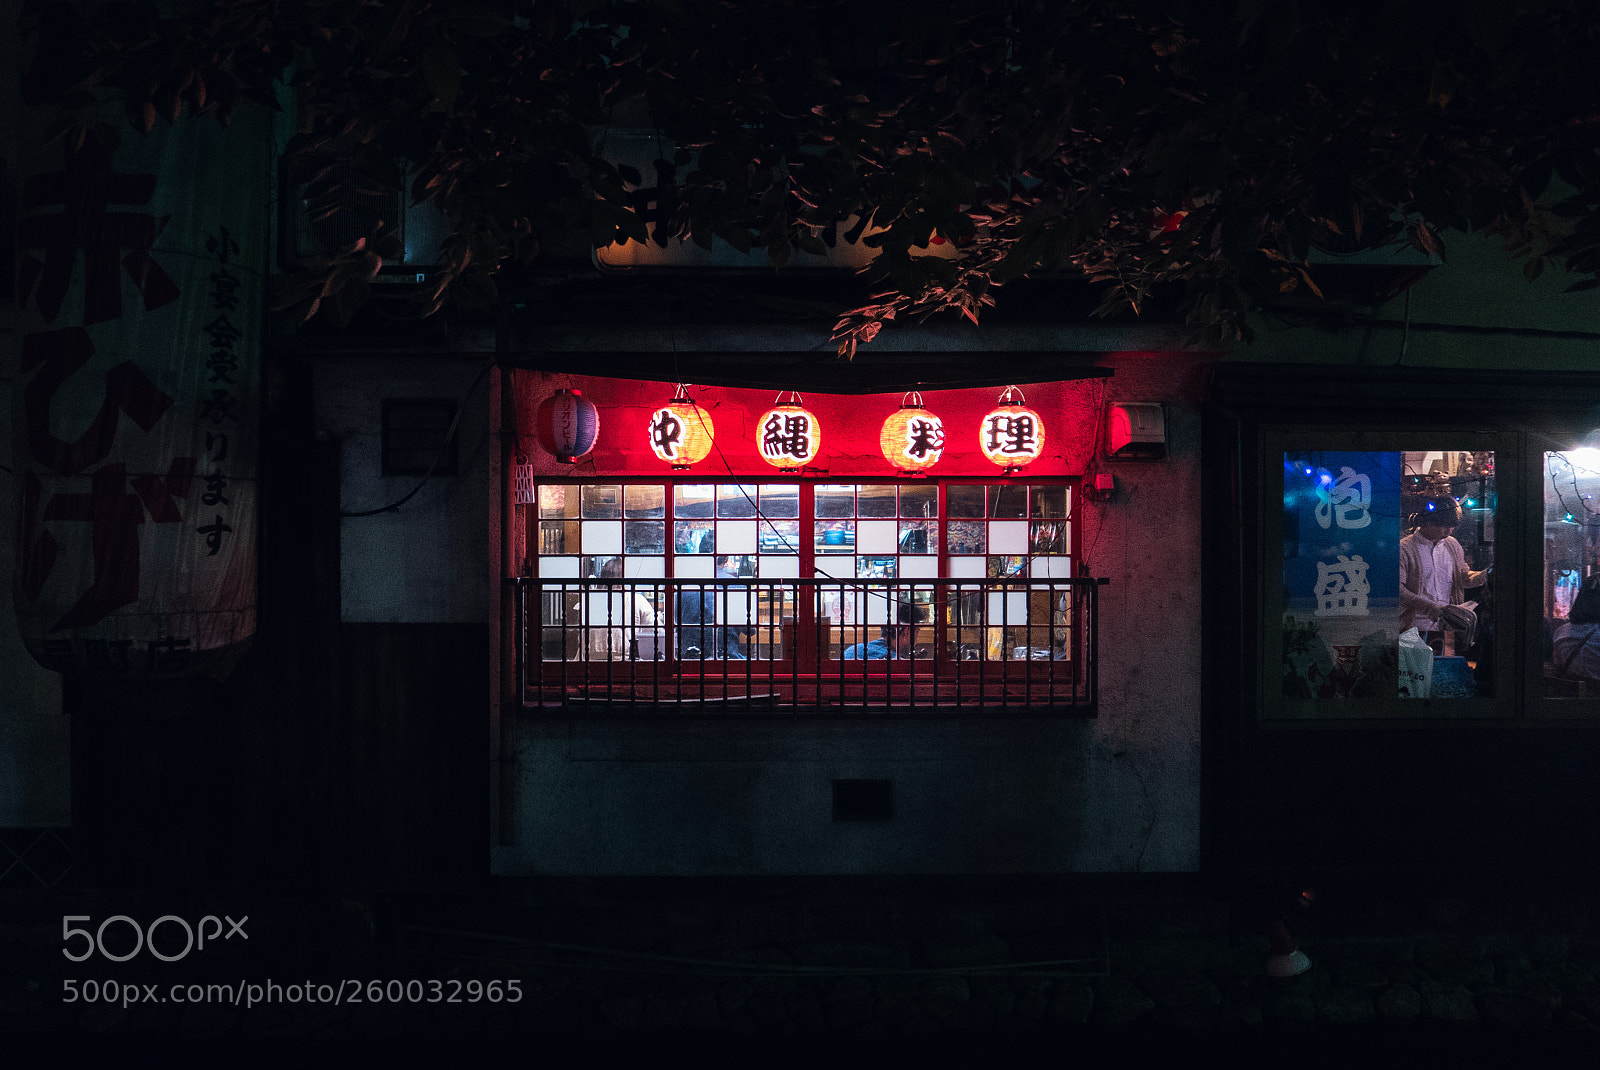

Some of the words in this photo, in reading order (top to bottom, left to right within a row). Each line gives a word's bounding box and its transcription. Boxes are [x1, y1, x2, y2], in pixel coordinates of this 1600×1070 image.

[20, 126, 195, 633] 赤ひげ
[763, 413, 812, 459] 縄
[986, 413, 1037, 455] 理
[1314, 466, 1371, 616] 泡盛
